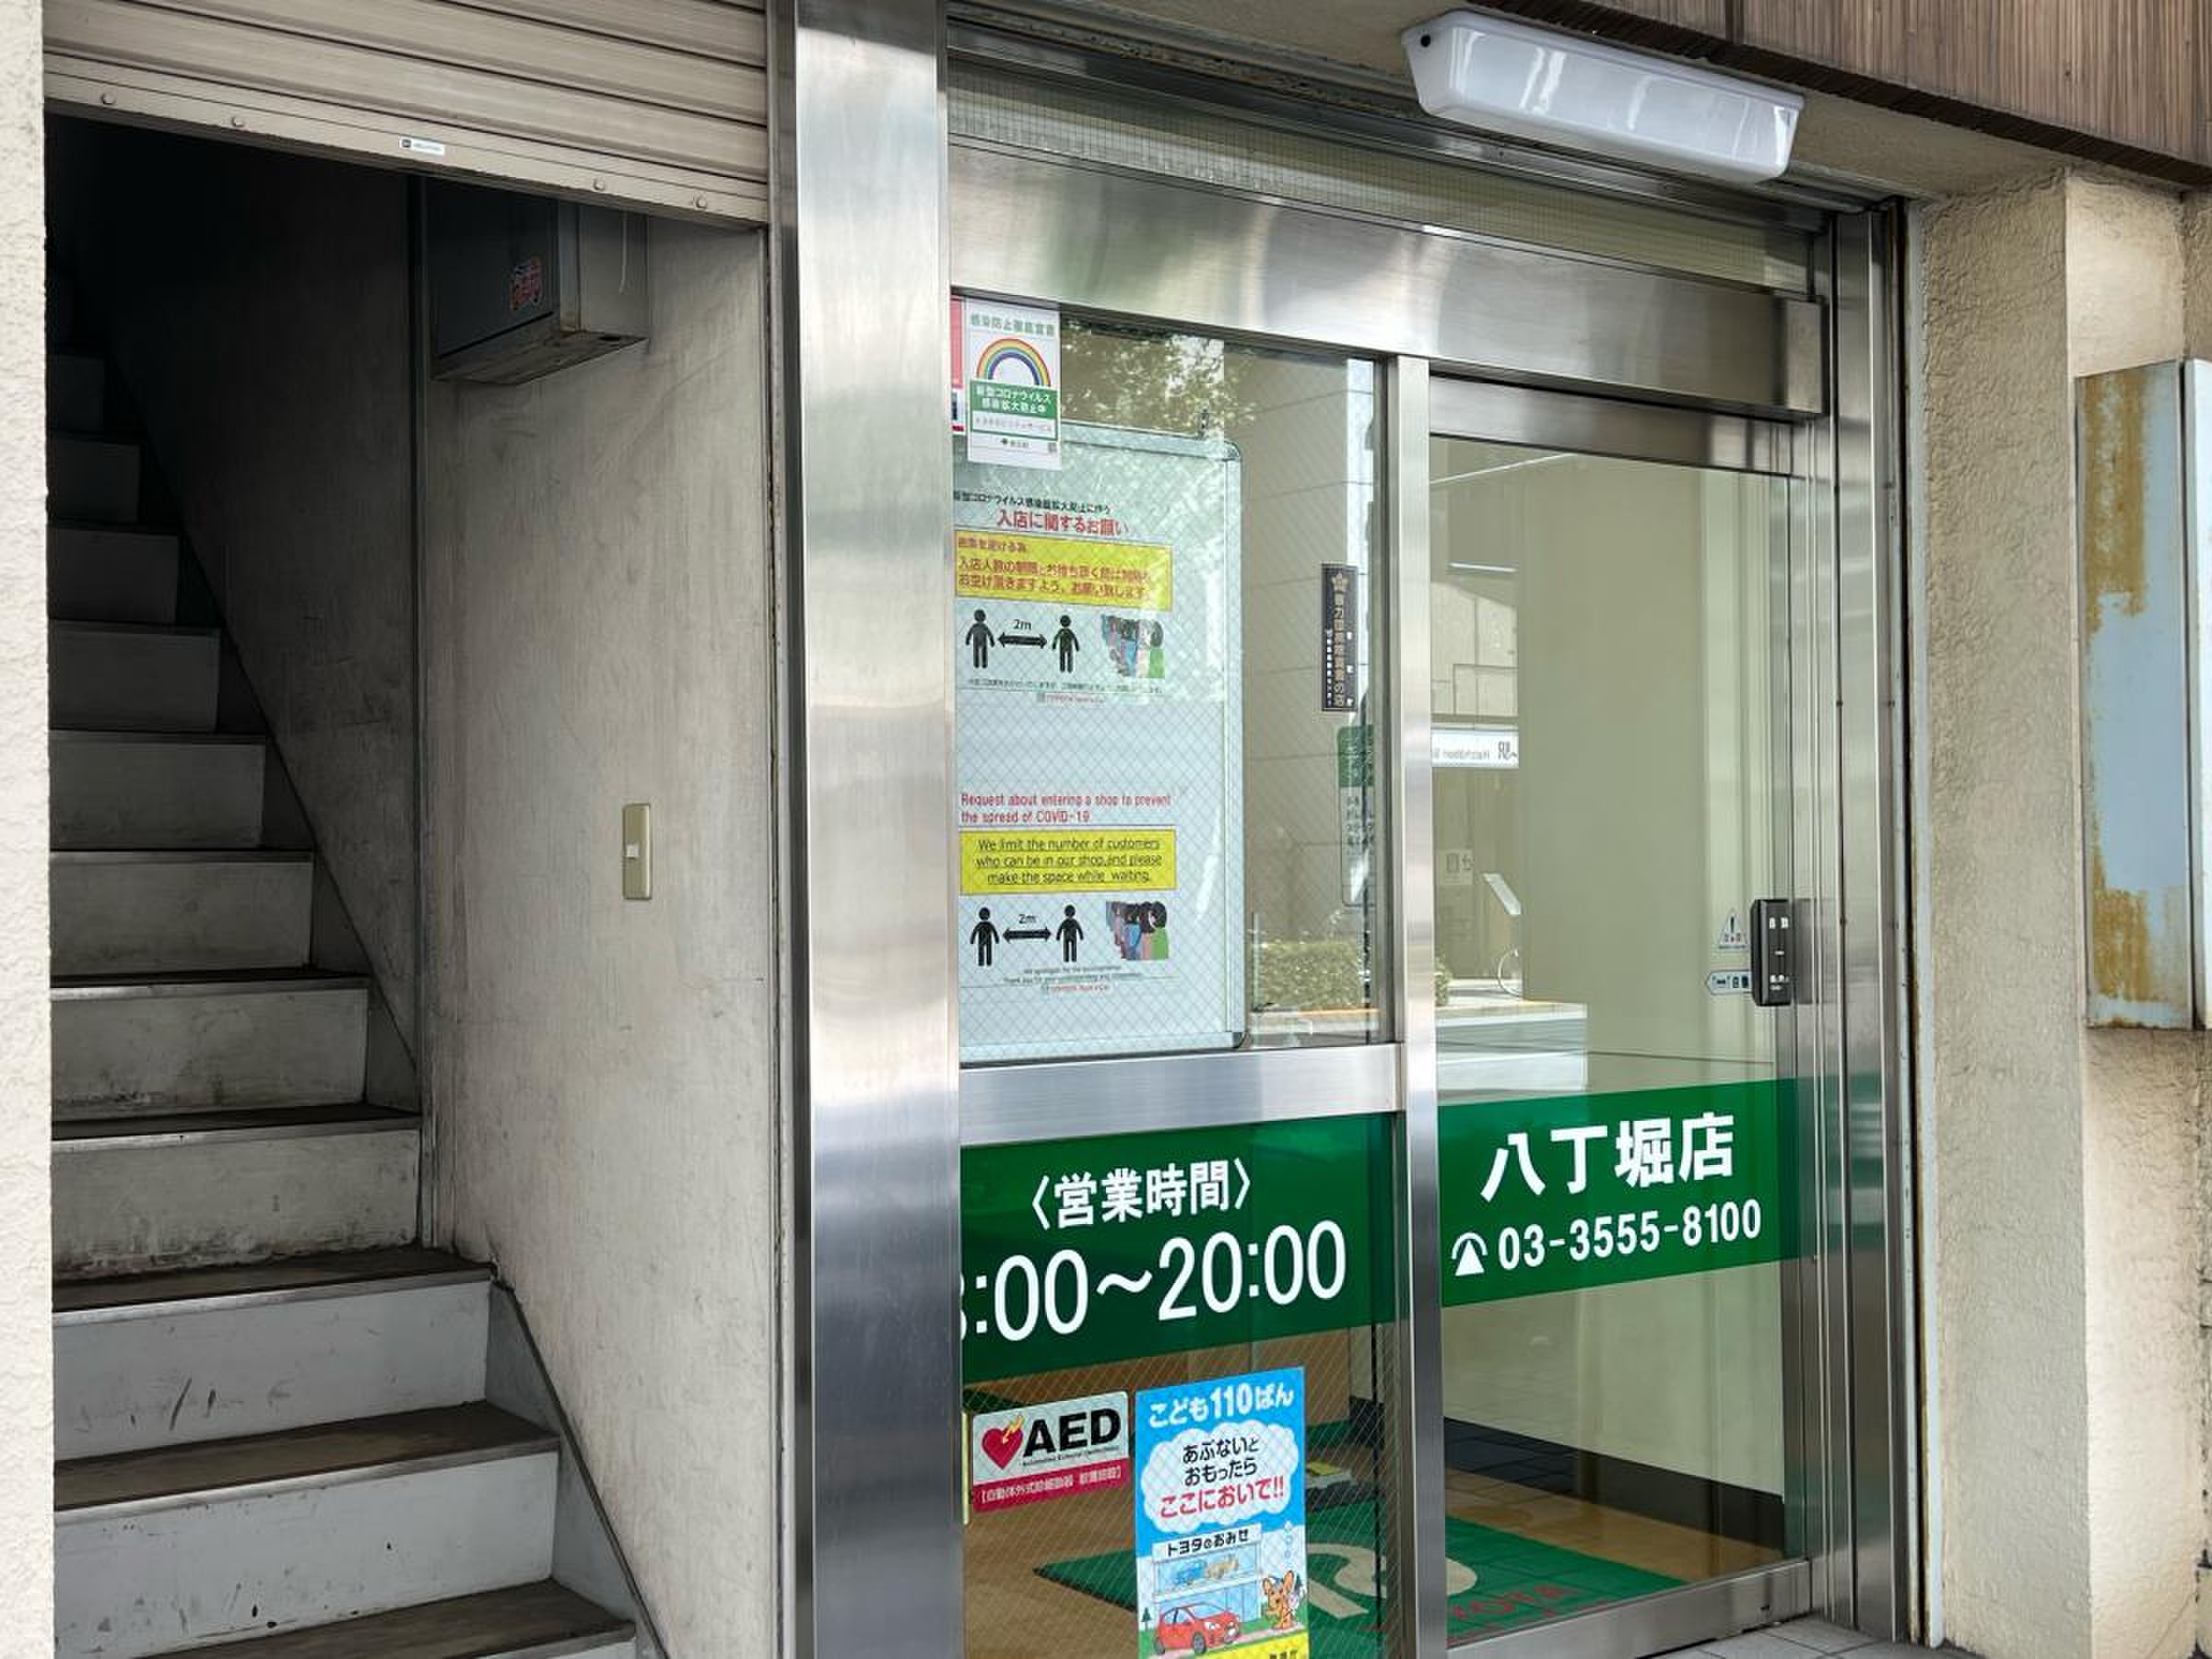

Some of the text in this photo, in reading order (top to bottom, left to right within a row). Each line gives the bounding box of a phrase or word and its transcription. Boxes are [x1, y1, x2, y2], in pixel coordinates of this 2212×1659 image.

[996, 511, 1130, 536] 入店に関するお願い
[1013, 618, 1032, 630] 2m
[960, 794, 1004, 806] Request
[1008, 794, 1036, 806] about
[960, 811, 979, 823] the
[1036, 810, 1091, 823] COVID-19
[978, 839, 996, 851] We
[1027, 839, 1046, 851] the
[1048, 838, 1090, 851] number
[1093, 838, 1104, 849] of
[976, 855, 1000, 868] who
[1004, 856, 1024, 867] can
[987, 872, 1018, 885] make
[1021, 871, 1040, 884] the
[1042, 872, 1074, 885] space
[1018, 914, 1036, 924] 2m
[1480, 1112, 1735, 1203] 八丁堀店
[1498, 1199, 1762, 1271] 03-3555-8100
[1149, 1382, 1295, 1429] こども110ばん
[1022, 1407, 1122, 1458] AED
[1182, 1435, 1260, 1465] あぶないと
[1184, 1457, 1258, 1488] おもったら
[1167, 1528, 1250, 1558] トヨタのおみせ
